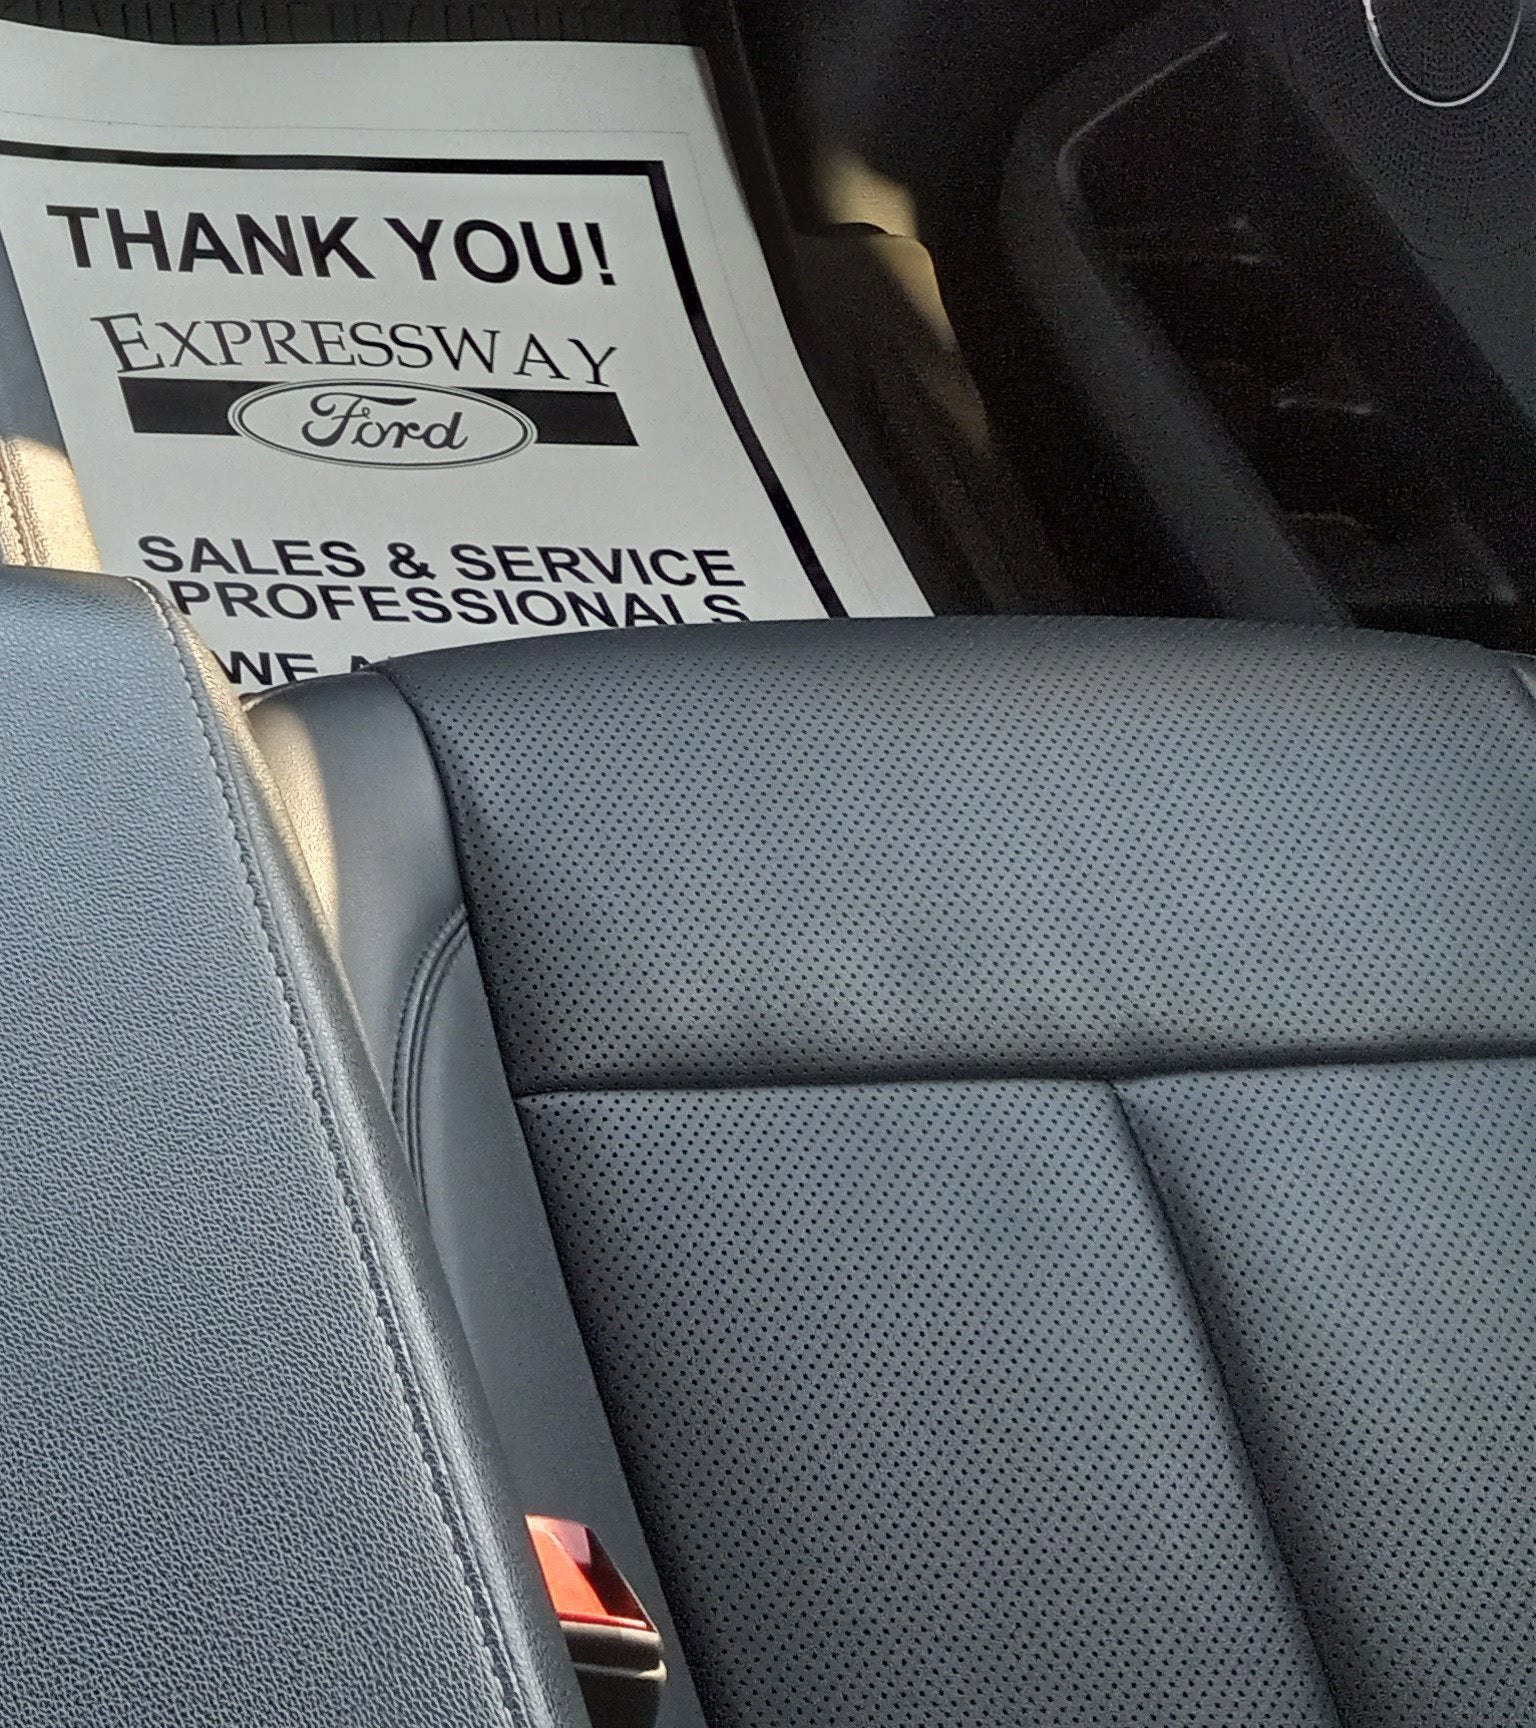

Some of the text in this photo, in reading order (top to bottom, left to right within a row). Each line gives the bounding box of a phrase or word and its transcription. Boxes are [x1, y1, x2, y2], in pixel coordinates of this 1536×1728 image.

[45, 204, 618, 287] THANK YOU!
[89, 312, 618, 387] EXPRESSWAY
[301, 391, 469, 452] Ford
[138, 535, 746, 587] SALES & SERVICE
